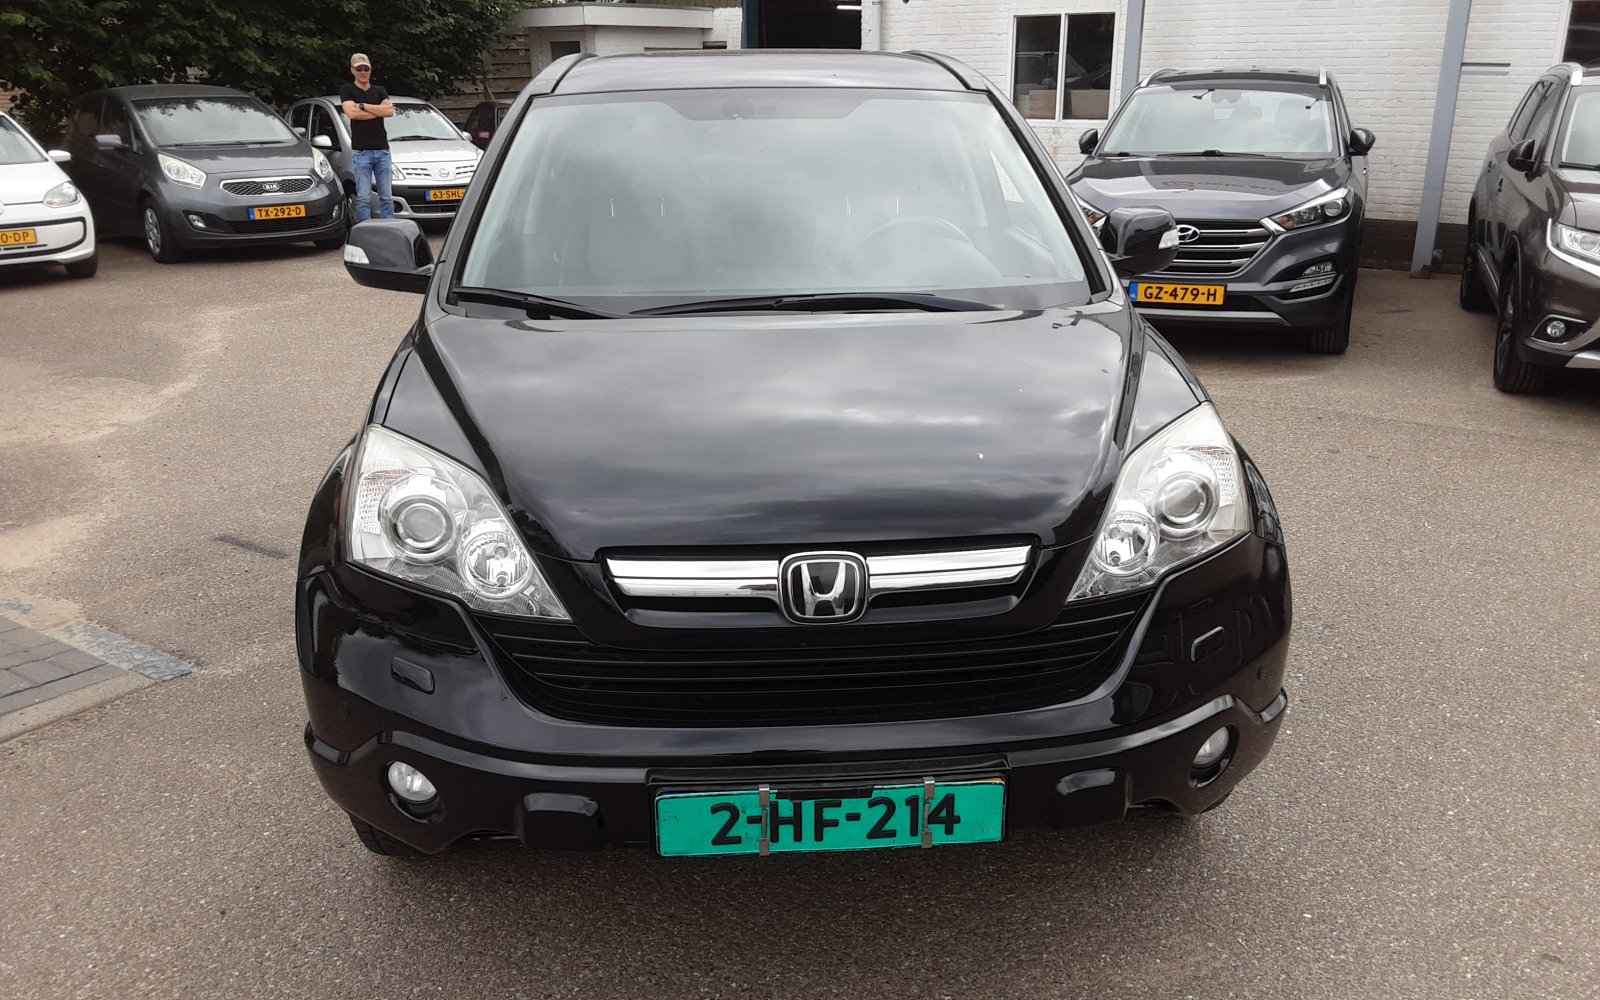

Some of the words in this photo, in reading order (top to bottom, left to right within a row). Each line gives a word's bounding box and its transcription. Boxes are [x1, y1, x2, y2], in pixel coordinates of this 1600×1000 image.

[433, 190, 465, 199] 63-SHL-
[257, 206, 302, 218] TX-292-D
[1143, 285, 1217, 302] GZ-479-H
[710, 793, 961, 846] 2-HF-214
